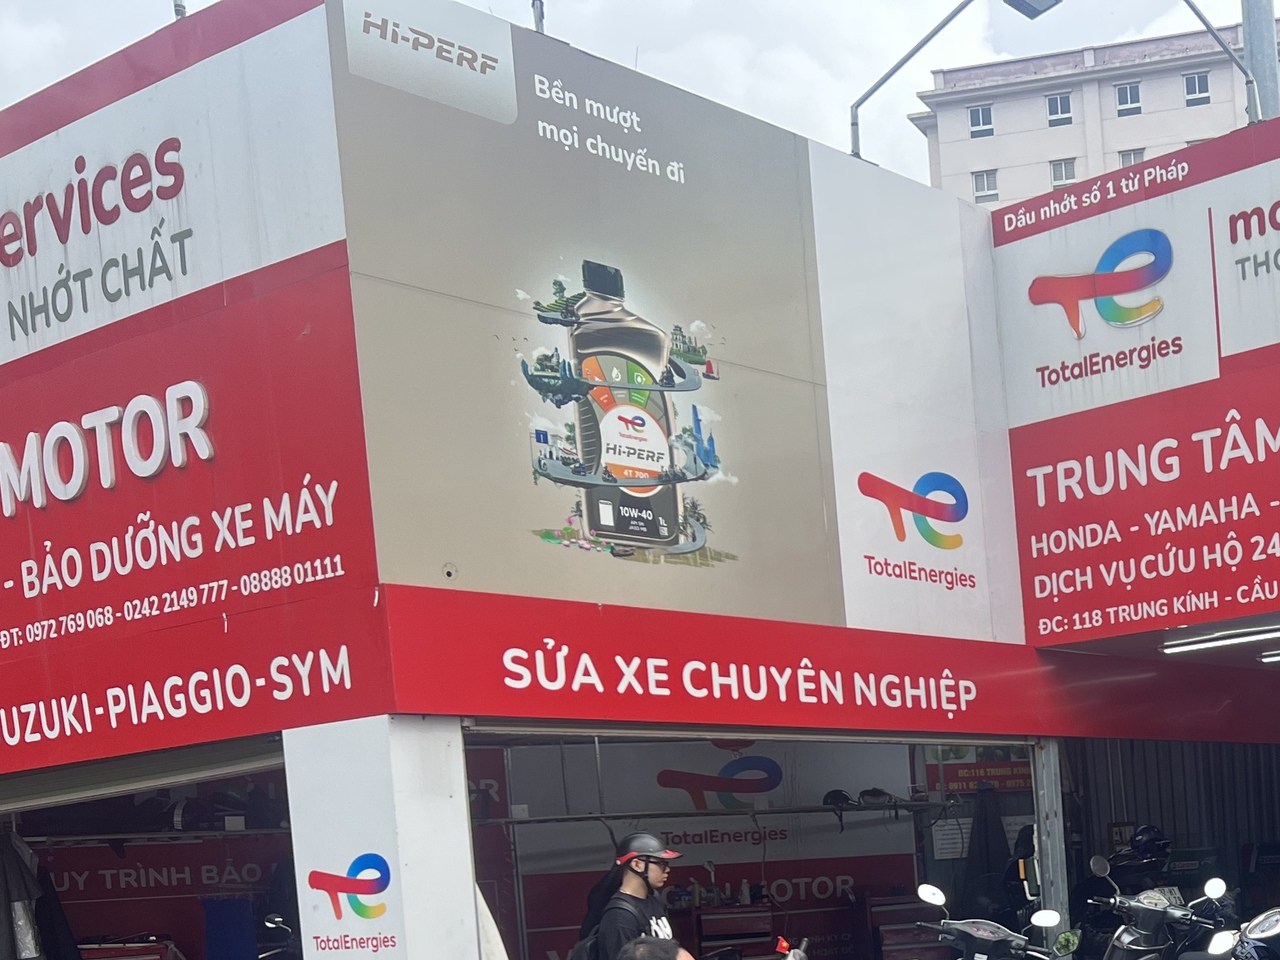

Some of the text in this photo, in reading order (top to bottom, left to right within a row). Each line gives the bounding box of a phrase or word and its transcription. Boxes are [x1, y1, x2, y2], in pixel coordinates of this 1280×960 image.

[534, 74, 641, 133] Bền mượt
[538, 120, 685, 184] mọi chuyến đi
[1003, 158, 1190, 232] Dầu nhớt số 1 từ Pháp
[8, 218, 193, 341] NHỚT CHẤT
[1035, 335, 1183, 390] TotalEnergies
[0, 380, 214, 517] MOTOR
[623, 469, 633, 477] 4T
[1026, 439, 1180, 509] TRUNG
[21, 473, 338, 598] BẢO DƯỠNG XE MÁY
[620, 506, 653, 520] 10W-40
[1031, 521, 1122, 559] HONDA
[1144, 494, 1260, 537] YAMAHA
[863, 554, 976, 590] TotalEnergies
[1034, 567, 1093, 603] DỊCH
[1098, 558, 1136, 589] VỤ
[1139, 541, 1196, 582] CỨU
[1202, 534, 1244, 573] HỘ
[0, 555, 345, 648] ĐT: 0972 769 068 0242 2149 777 08888 01111
[1038, 616, 1069, 637] ĐC:
[1072, 609, 1103, 631] 118
[1105, 598, 1168, 626] TRUNG
[1172, 583, 1219, 615] KÍNH
[1236, 576, 1277, 606] CẦU
[502, 638, 977, 719] SỬA XE CHUYÊN NGHIỆP
[660, 828, 788, 846] TotalEnergies
[98, 863, 191, 890] TRÌNH
[757, 875, 856, 903] OTOR
[313, 934, 397, 953] TotalEnergies
